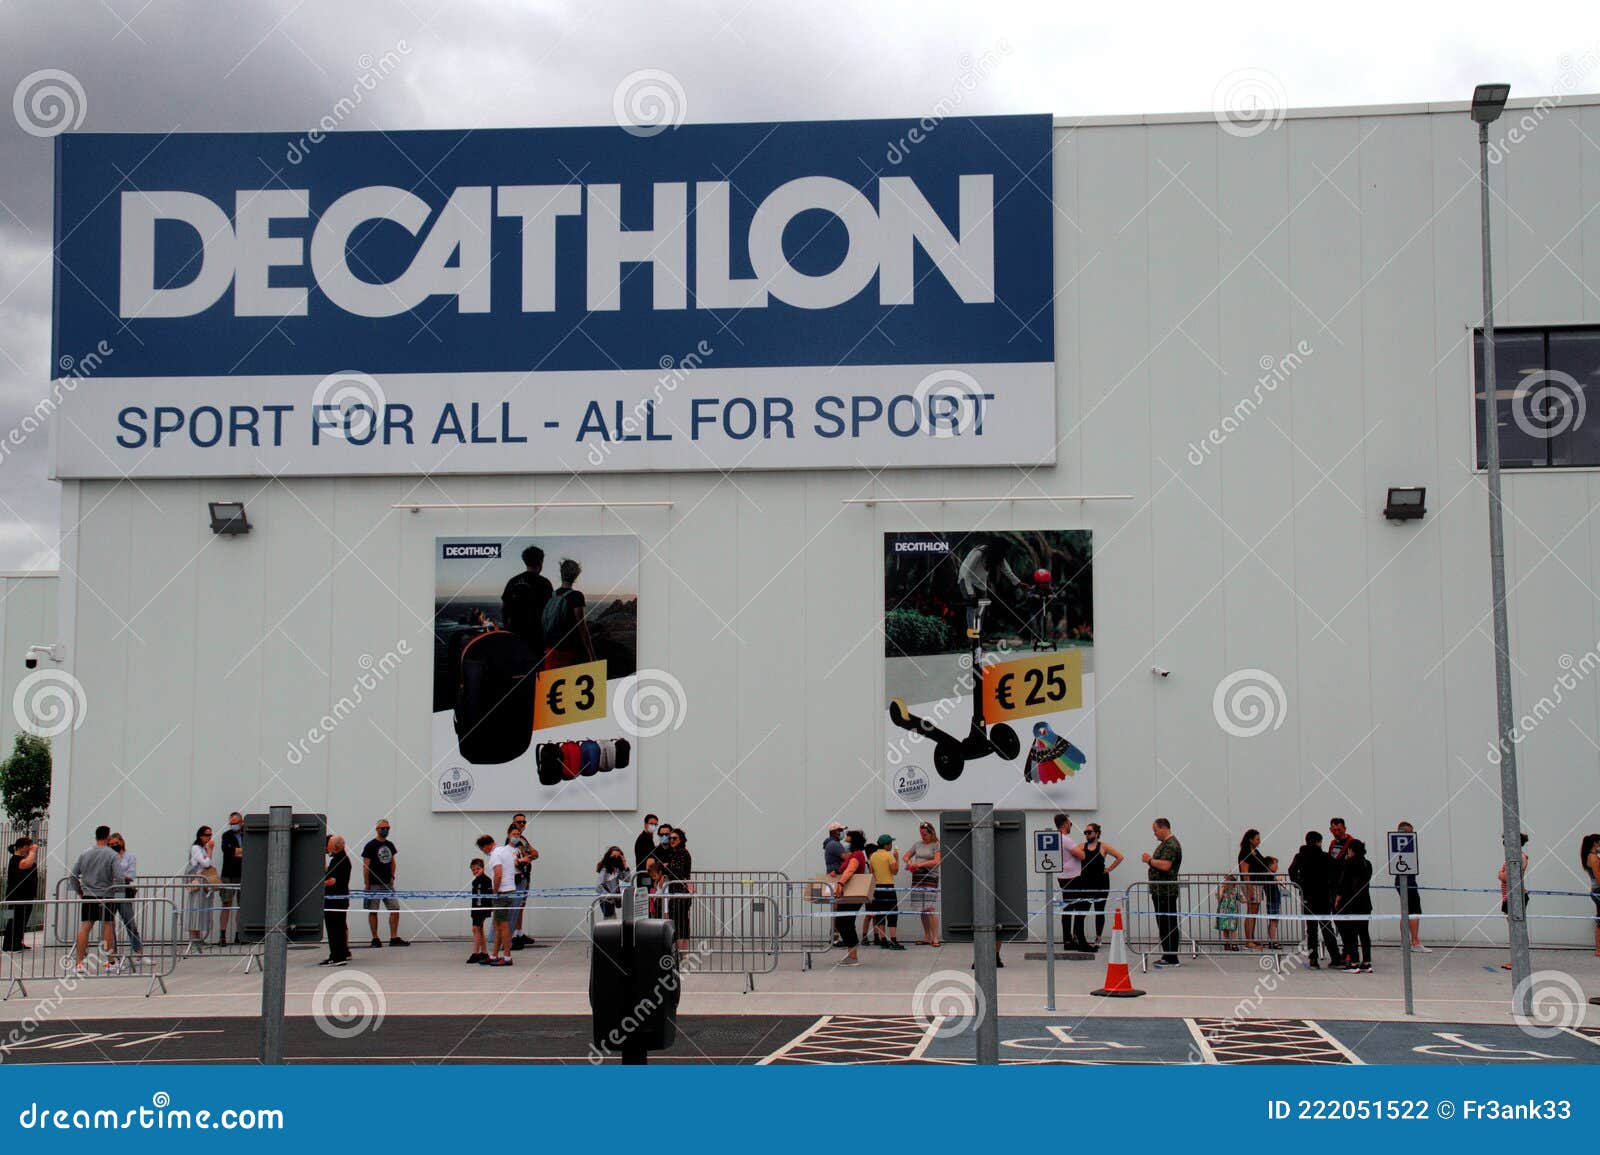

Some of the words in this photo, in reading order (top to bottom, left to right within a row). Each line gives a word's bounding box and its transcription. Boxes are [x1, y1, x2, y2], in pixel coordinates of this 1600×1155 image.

[119, 174, 995, 318] DECATHLON
[116, 405, 294, 448] SPORT
[312, 403, 414, 446] FOR
[431, 402, 528, 444] ALL
[575, 400, 672, 442] ALL
[691, 397, 795, 440] FOR
[813, 394, 995, 439] SPORT
[446, 546, 499, 556] DECATHLON
[895, 542, 949, 551] DECATHLON
[546, 679, 566, 715] €
[575, 674, 595, 710] 3
[995, 673, 1015, 710] €
[1024, 664, 1066, 706] 25
[899, 777, 905, 787] 2
[1043, 835, 1054, 849] P
[1397, 836, 1408, 851] P
